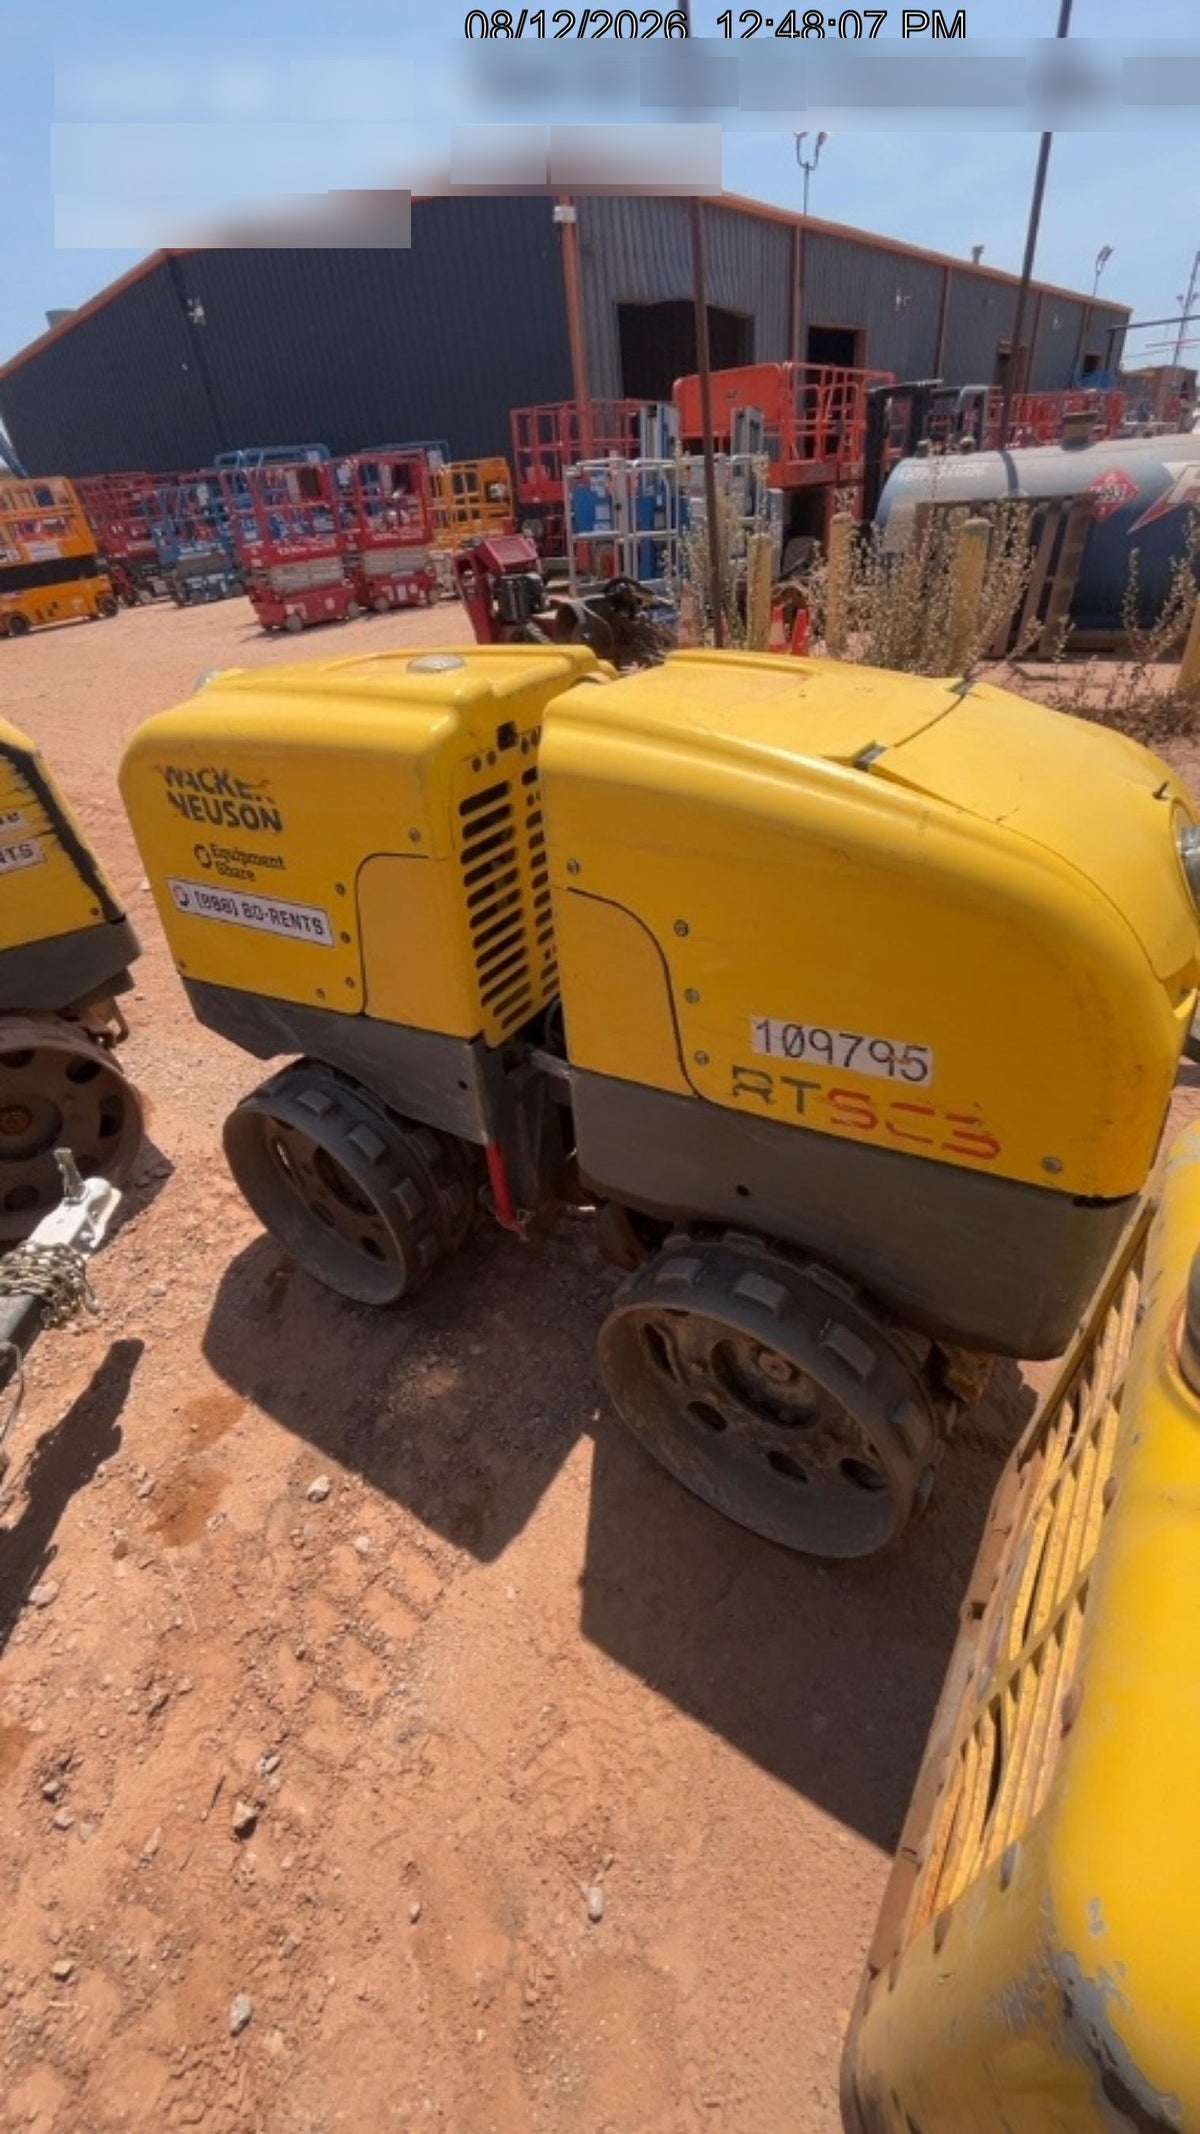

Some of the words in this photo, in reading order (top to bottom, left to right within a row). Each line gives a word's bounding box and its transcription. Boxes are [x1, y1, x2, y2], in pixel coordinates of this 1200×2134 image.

[166, 791, 283, 833] NEUSON
[209, 843, 286, 870] Equipment
[215, 861, 256, 881] Share
[241, 901, 324, 935] 80-RENTS
[755, 1019, 929, 1083] 109795
